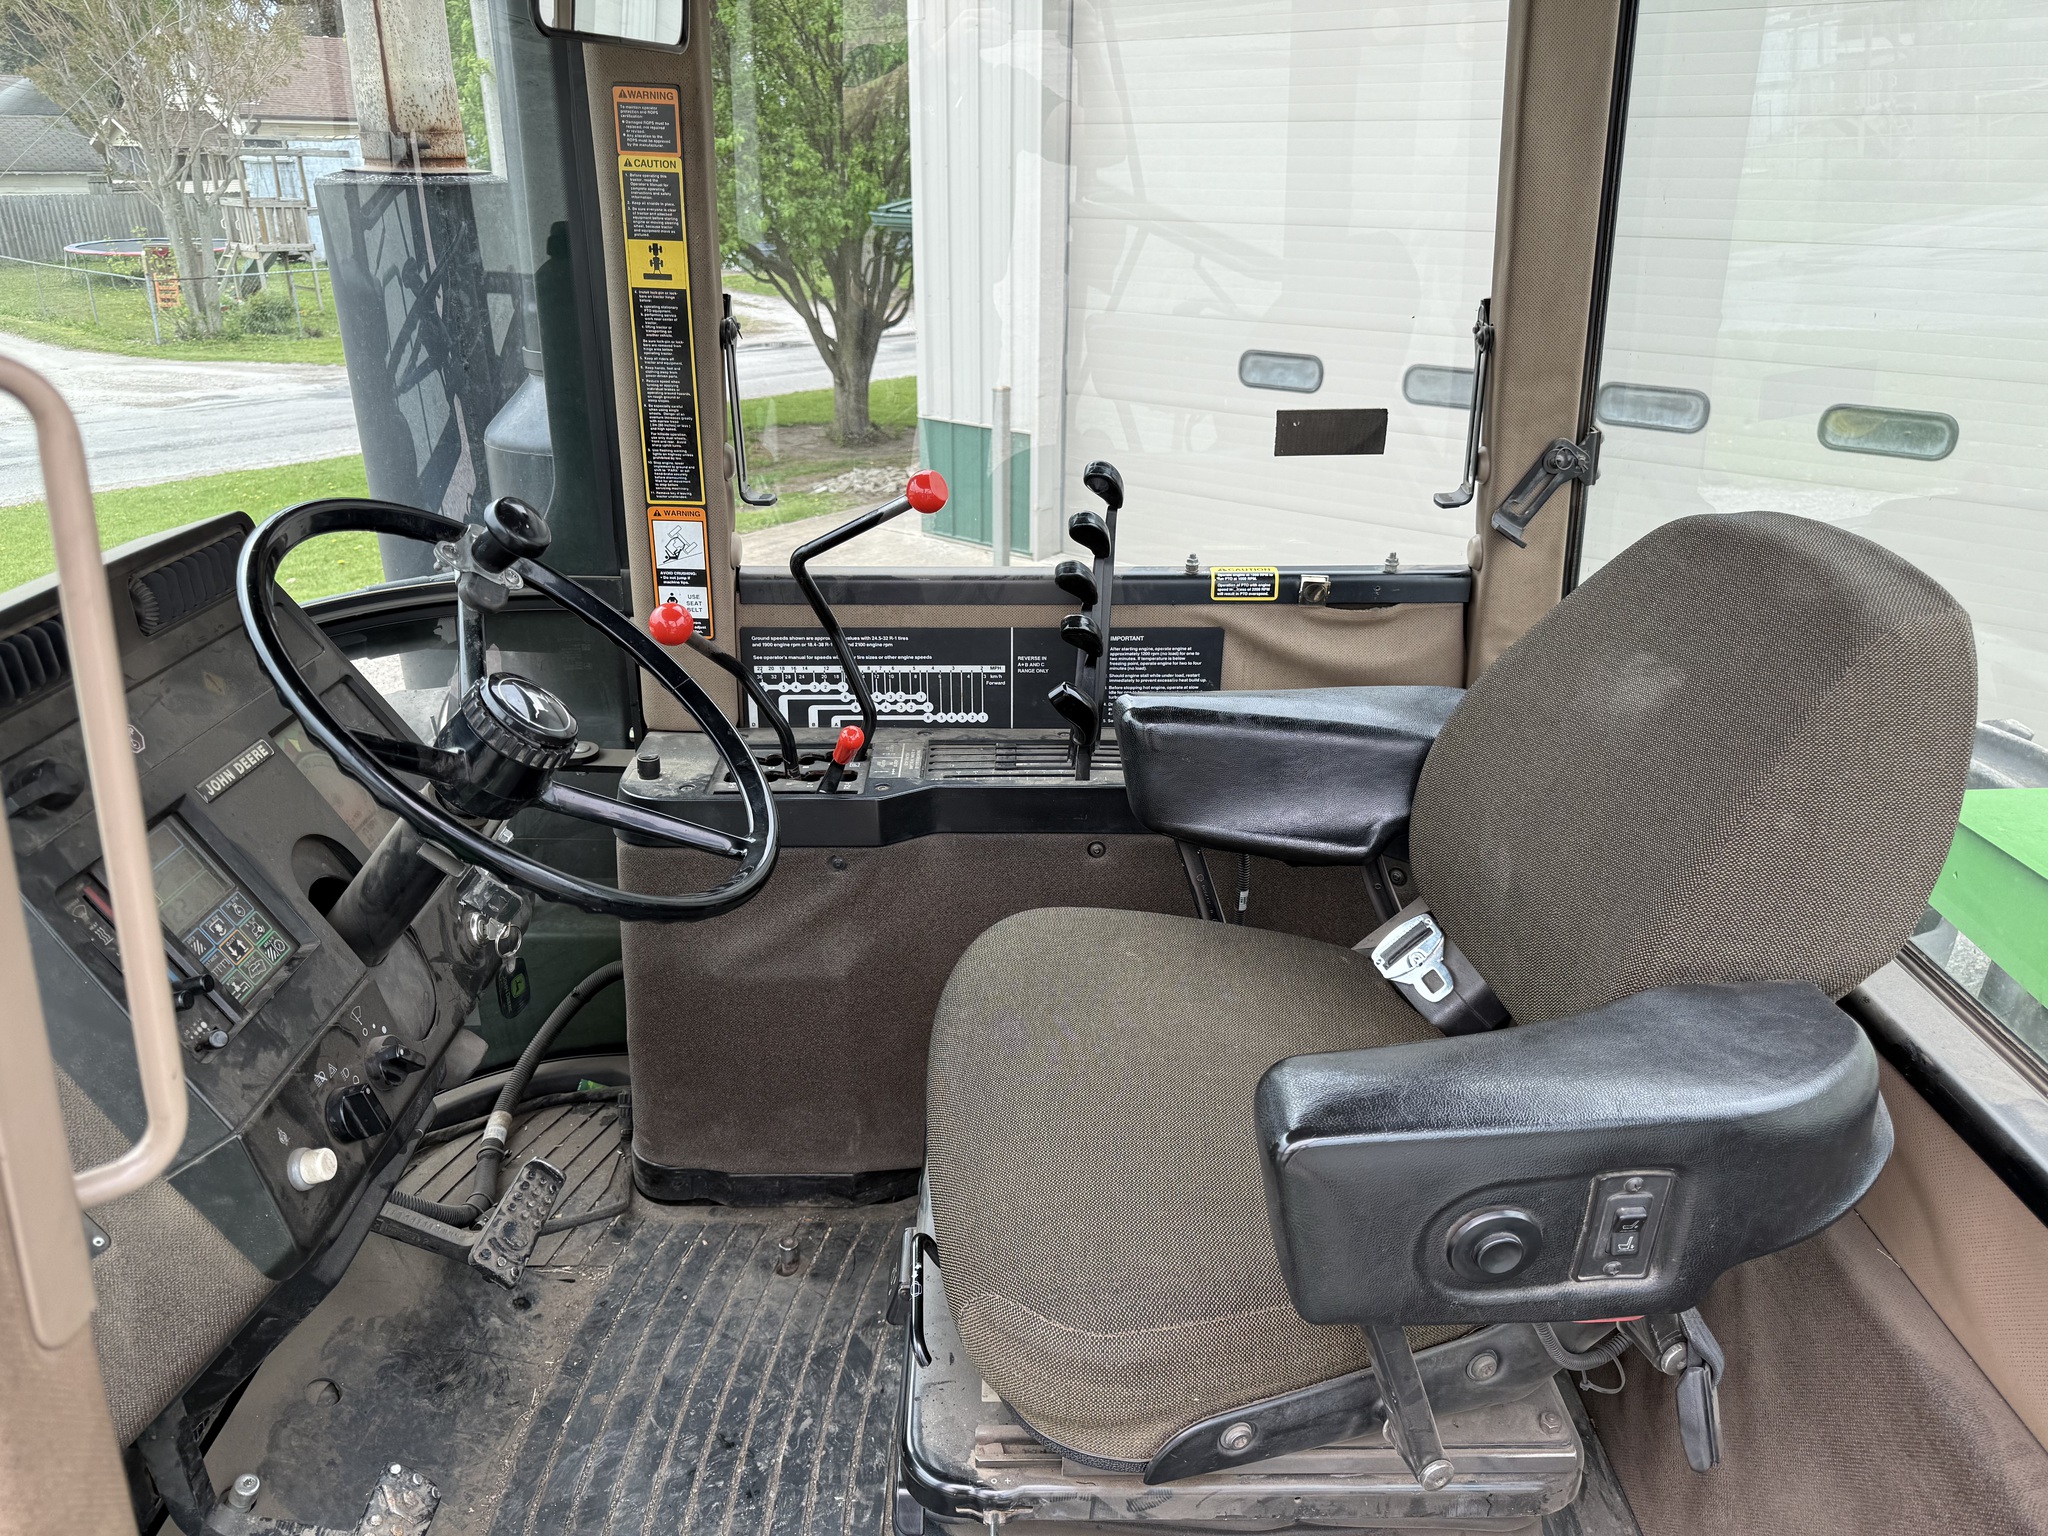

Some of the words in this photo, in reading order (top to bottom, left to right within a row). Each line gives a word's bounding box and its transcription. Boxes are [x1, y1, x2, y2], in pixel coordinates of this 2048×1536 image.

[627, 90, 674, 100] WARNING
[634, 159, 676, 169] CAUTION
[205, 768, 236, 796] JOHN
[233, 744, 269, 775] DEERE
